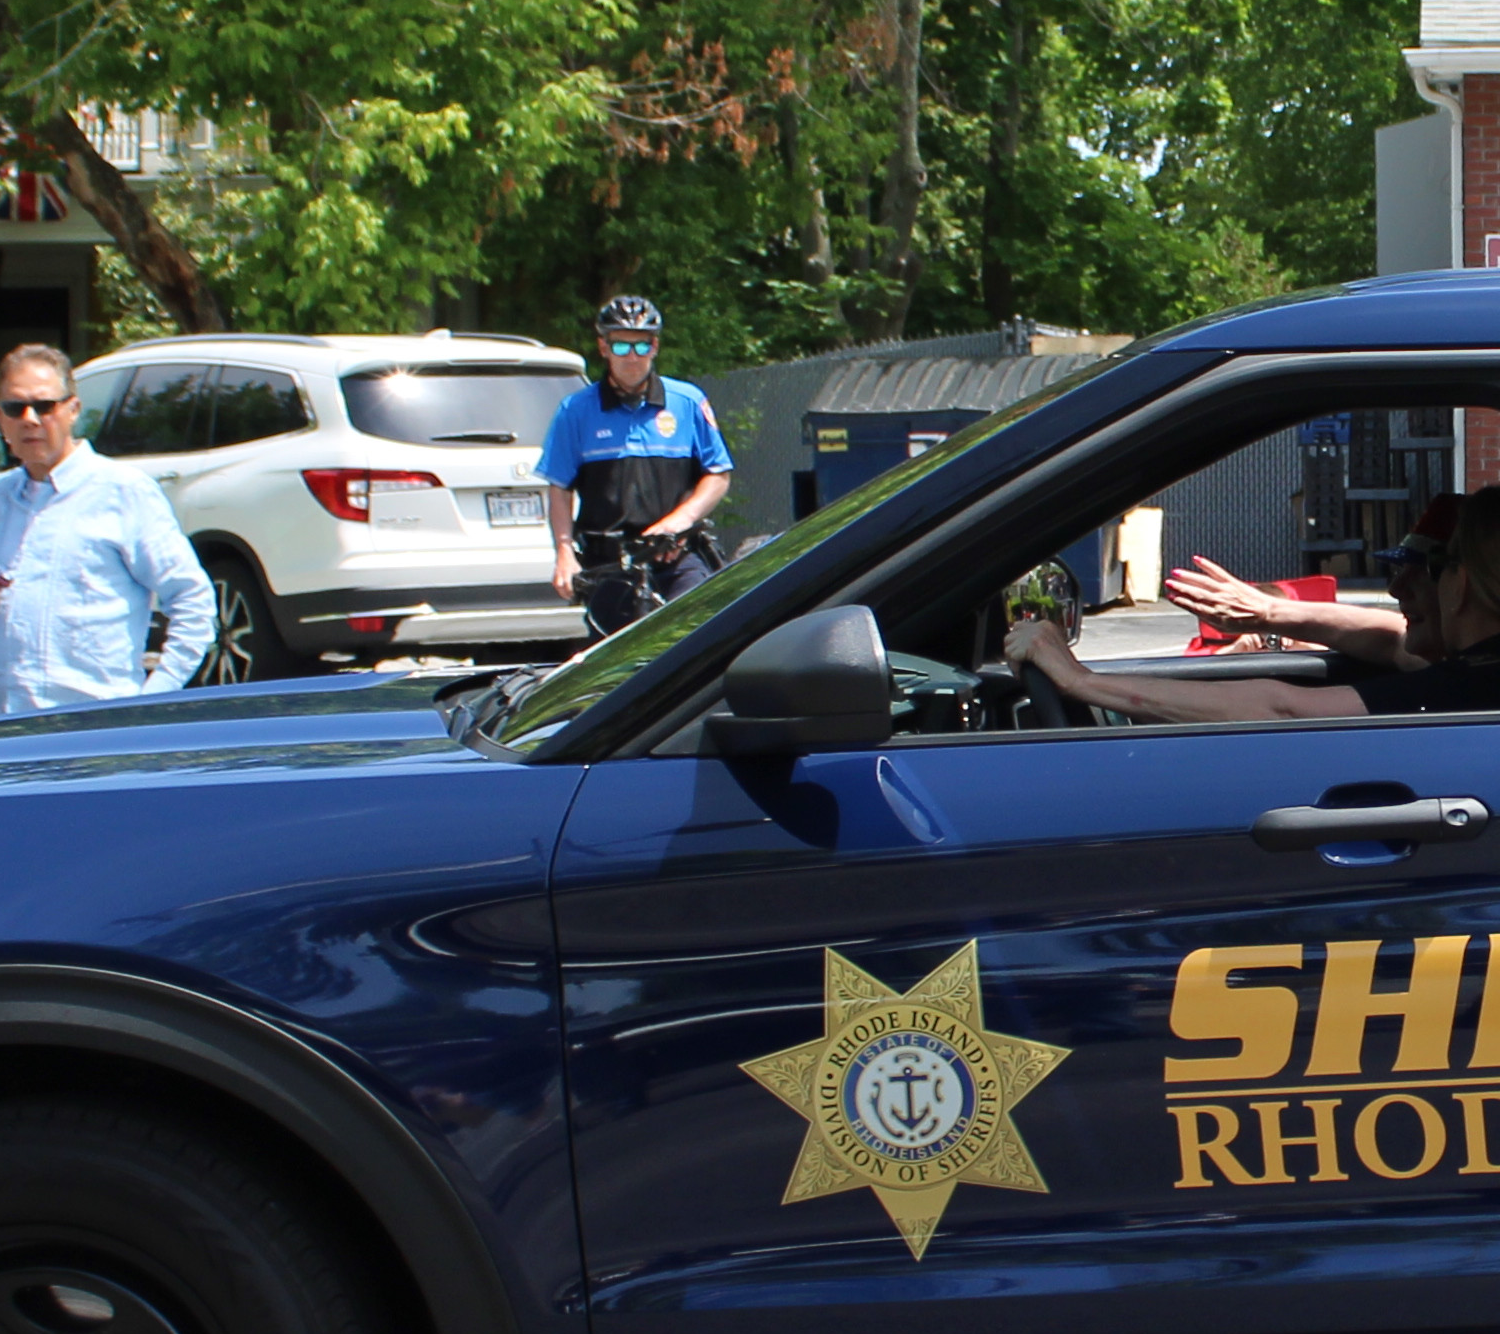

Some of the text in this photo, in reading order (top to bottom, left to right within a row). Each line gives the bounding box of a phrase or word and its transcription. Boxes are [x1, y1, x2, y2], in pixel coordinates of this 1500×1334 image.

[829, 1010, 985, 1069] RHODE ISLAND
[865, 1033, 950, 1060] STATE OF
[820, 1078, 998, 1183] DIVISION OF SHERIFFS
